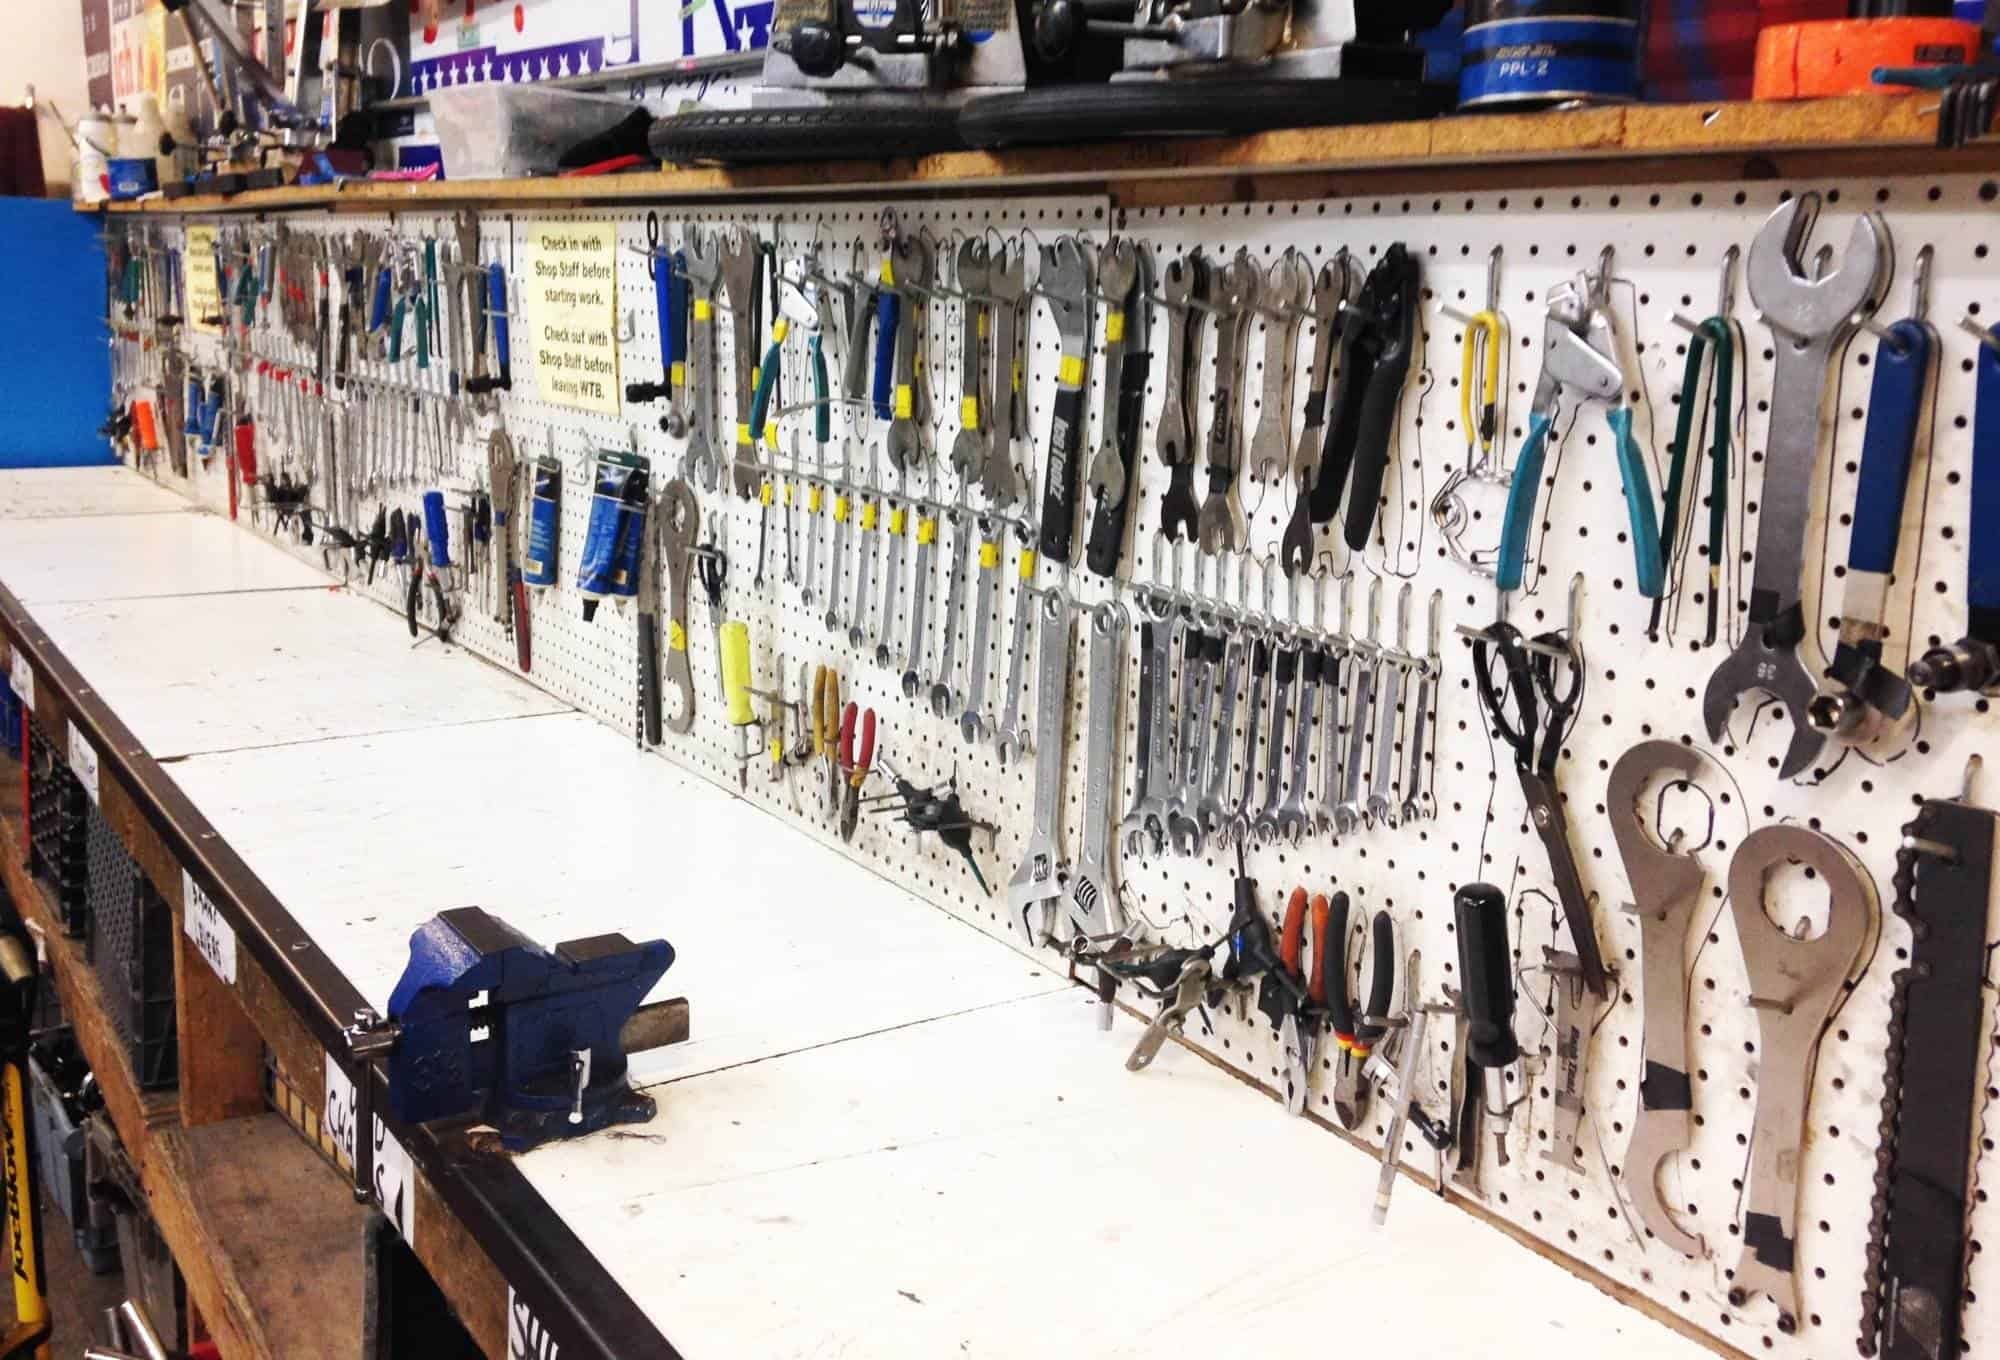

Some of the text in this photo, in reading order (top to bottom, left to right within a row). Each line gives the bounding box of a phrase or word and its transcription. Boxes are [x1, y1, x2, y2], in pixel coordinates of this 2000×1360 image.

[541, 235, 602, 251] Check in with
[535, 260, 611, 280] Shop Staff before
[544, 289, 605, 308] starting work.
[544, 325, 608, 346] Check out with
[539, 350, 613, 375] Shop Staff before
[551, 377, 578, 398] leaving
